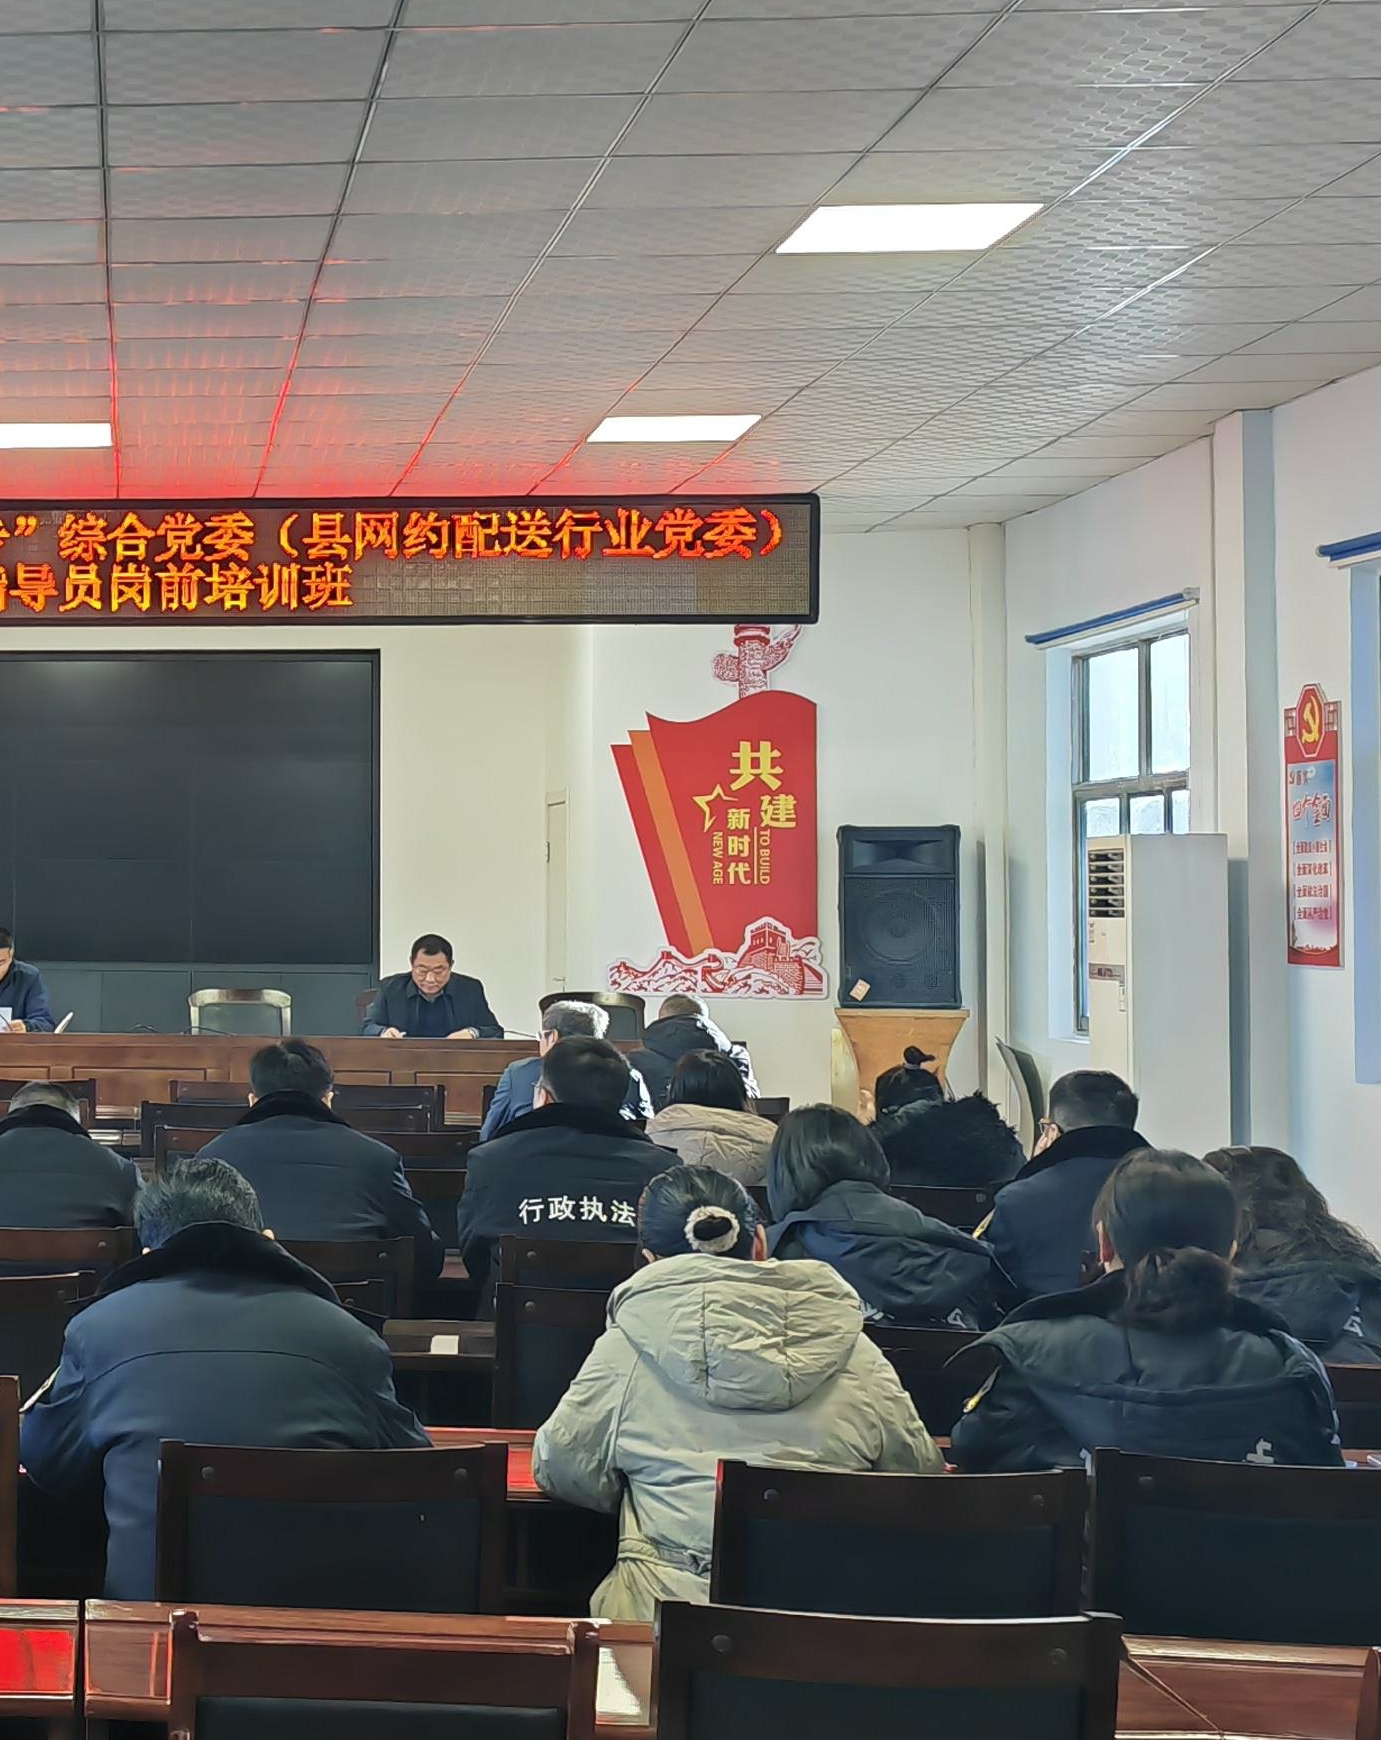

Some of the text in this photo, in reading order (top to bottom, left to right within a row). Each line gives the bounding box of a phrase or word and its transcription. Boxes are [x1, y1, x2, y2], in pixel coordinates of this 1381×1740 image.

[712, 831, 724, 885] NEW AGE
[727, 808, 751, 885] 新时代
[759, 828, 771, 885] TO BUILD
[518, 1194, 637, 1227] 行政执法
